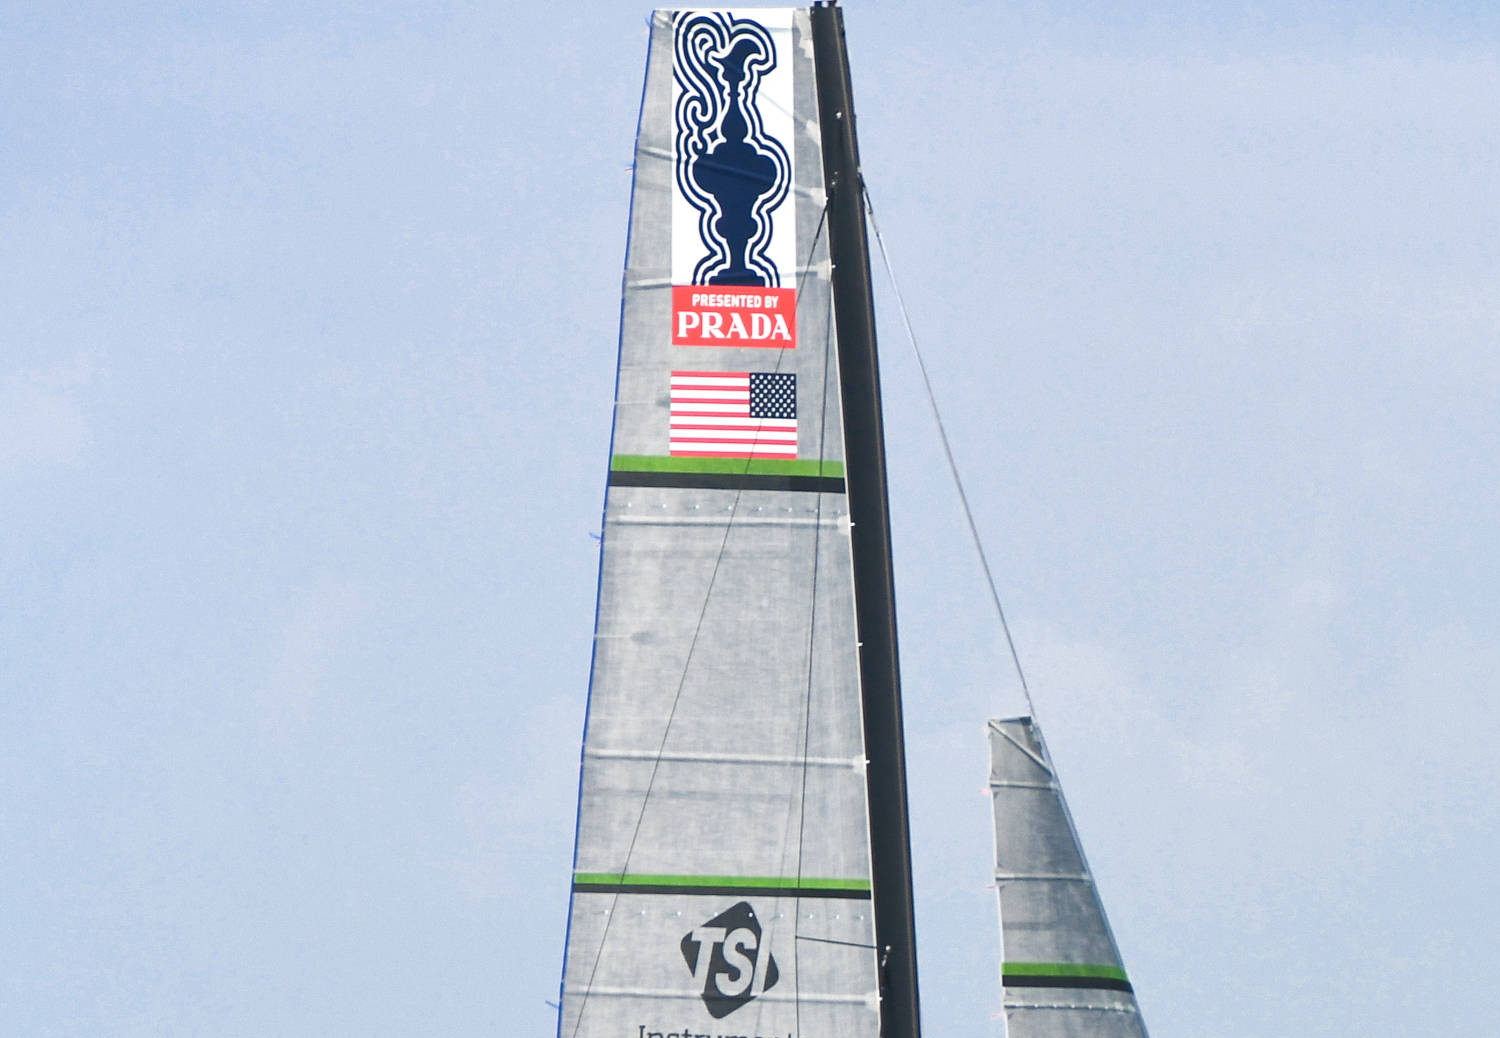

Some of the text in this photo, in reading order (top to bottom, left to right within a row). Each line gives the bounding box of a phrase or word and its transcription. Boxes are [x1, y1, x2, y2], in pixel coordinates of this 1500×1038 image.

[692, 293, 779, 308] PRESENTED BY
[677, 311, 792, 341] PRADA
[691, 926, 774, 997] TSI
